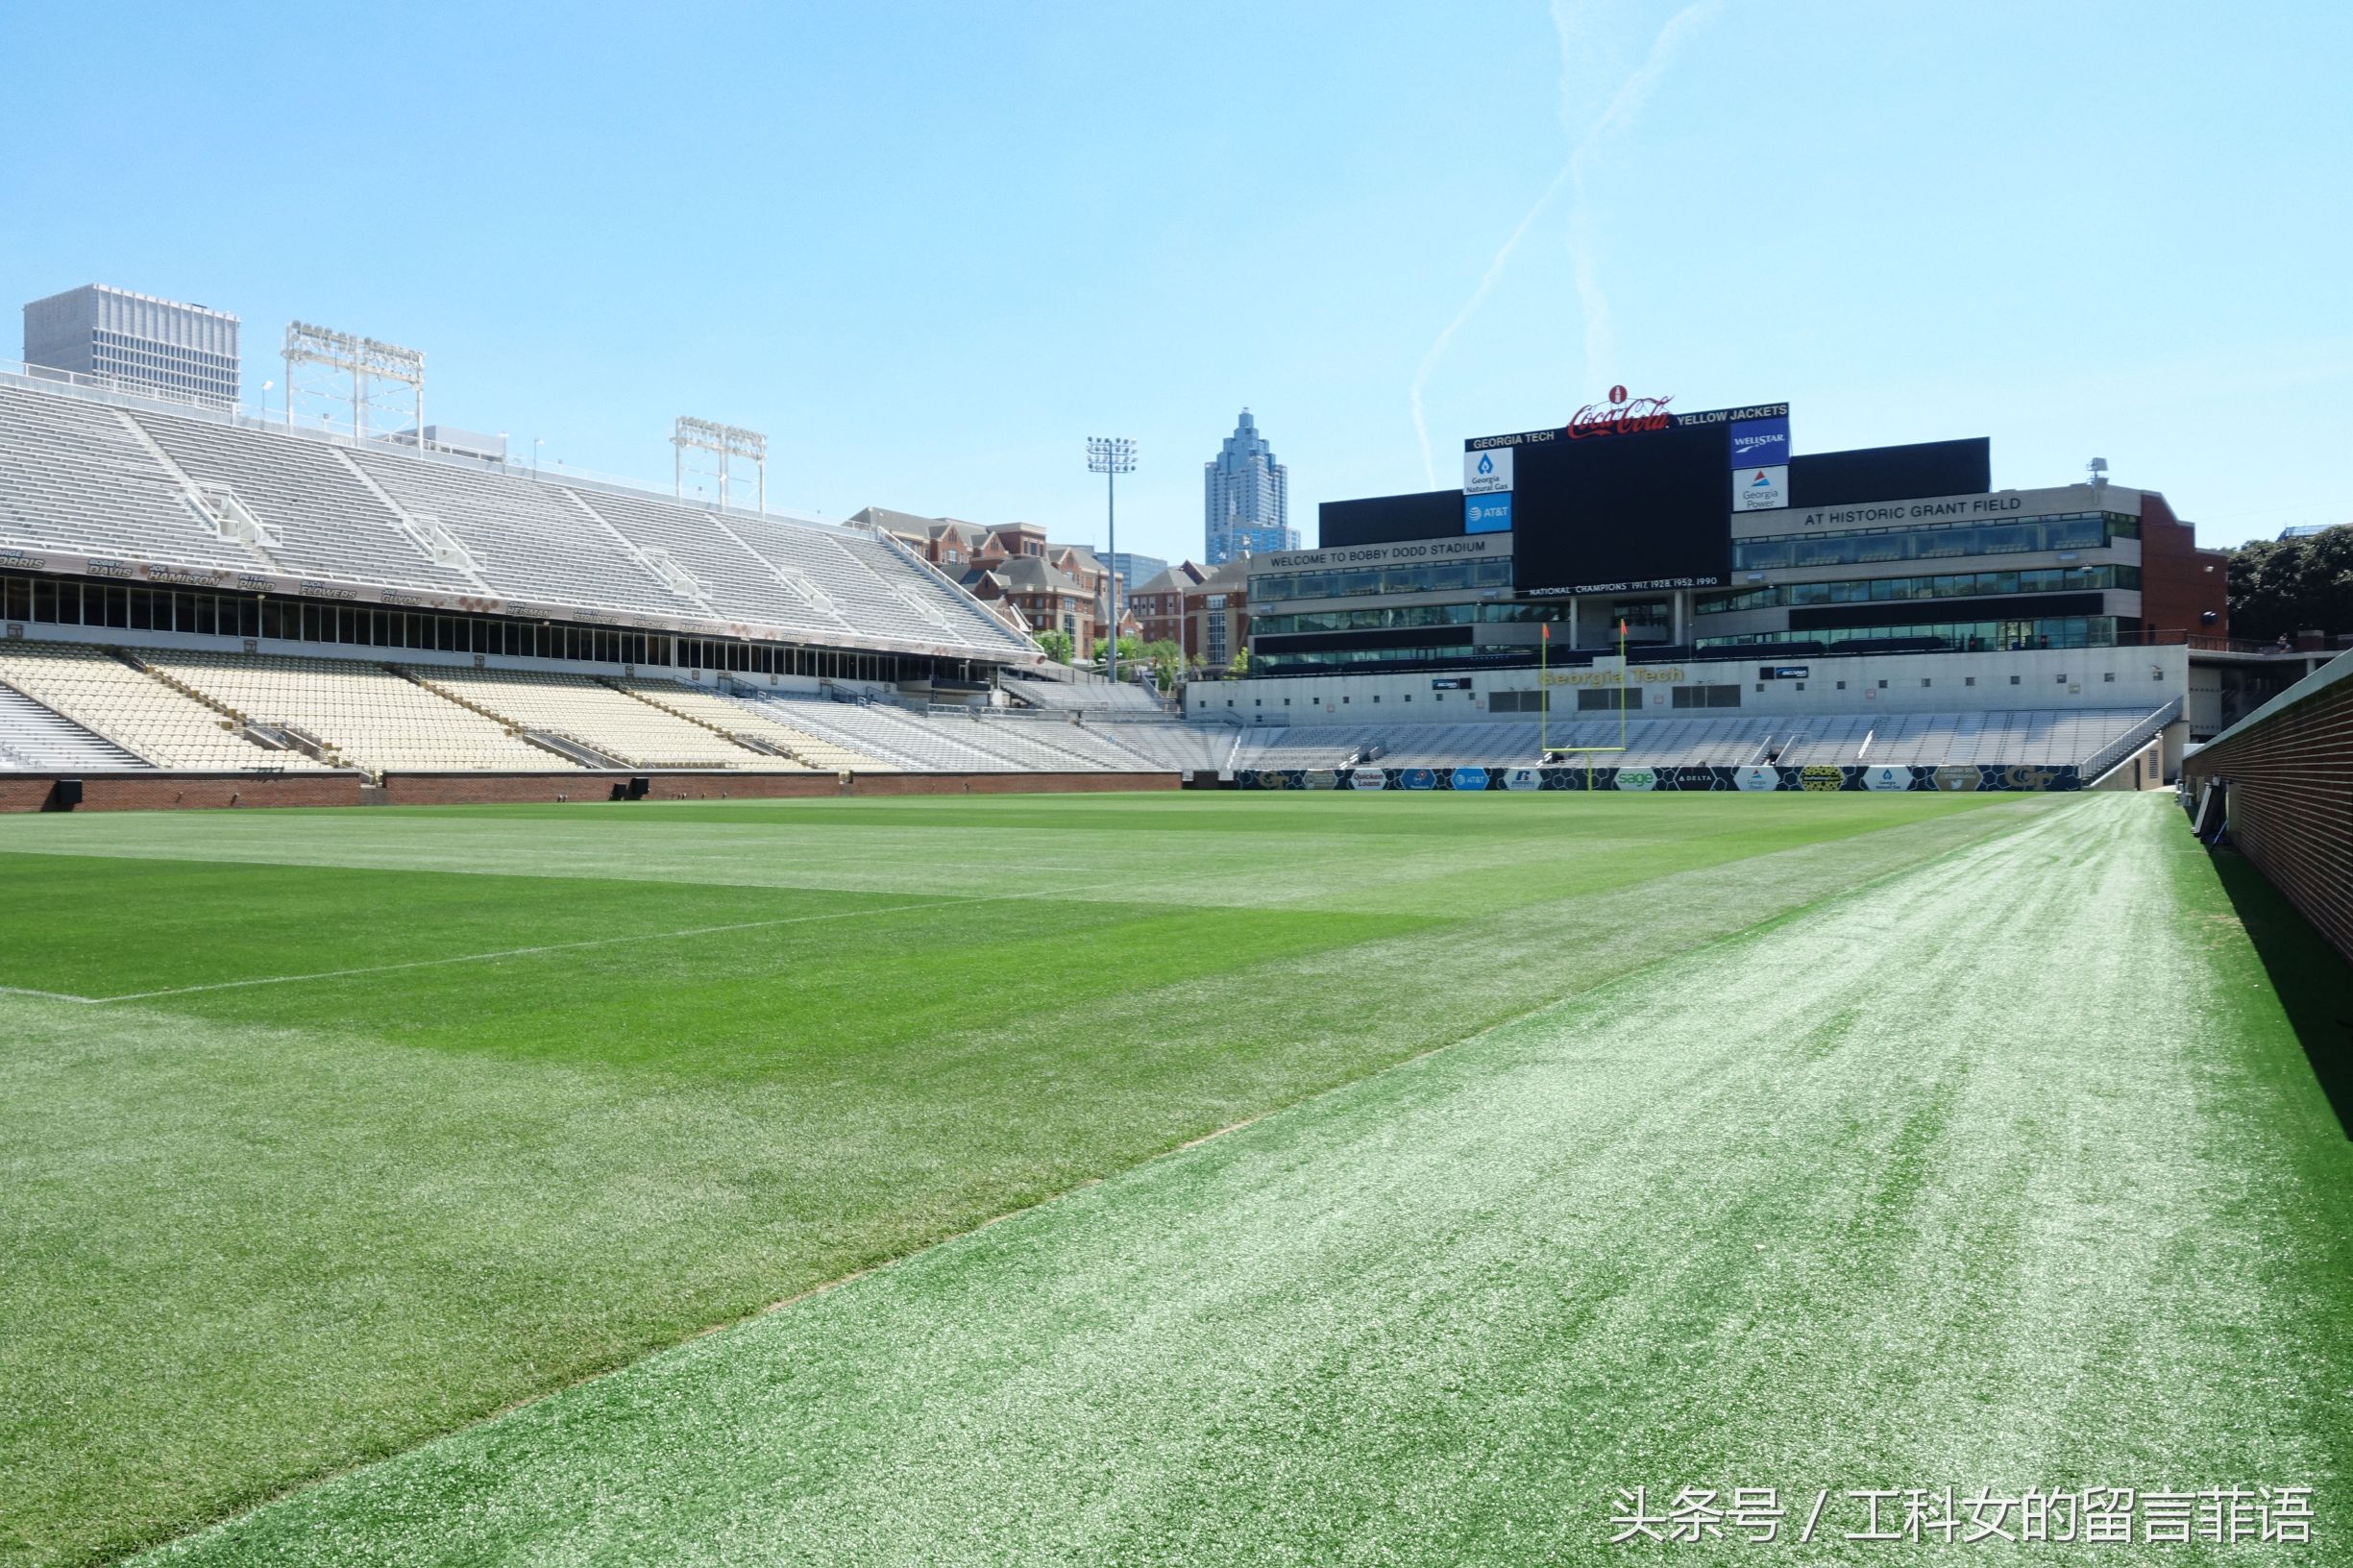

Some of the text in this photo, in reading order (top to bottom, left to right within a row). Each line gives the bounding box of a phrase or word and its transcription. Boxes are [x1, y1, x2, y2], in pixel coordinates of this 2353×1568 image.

[1678, 404, 1787, 426] YELLOW JACKETS
[1473, 430, 1555, 450] GEORGIA TECH
[1471, 476, 1500, 485] Georgia
[1466, 481, 1508, 493] Natural Gas
[1743, 489, 1778, 500] Georgia
[1747, 500, 1775, 508] Power
[1483, 506, 1508, 518] AT&T
[1804, 497, 2022, 526] AT HISTORIC GRANT FIELD
[1270, 541, 1485, 568] WELCOME TO BOBBY DODD STADIUM
[87, 557, 124, 568] BOBBY
[86, 565, 134, 578] DAVIS
[148, 572, 221, 587] HAMILTON
[237, 574, 266, 582] PETER
[236, 580, 276, 592] PUND
[1530, 586, 1571, 597] NATIONAL
[1575, 582, 1628, 594] CHAMPIONS
[1697, 576, 1718, 585] 1990
[299, 586, 357, 600] FLOWERS
[380, 595, 423, 606] GUYON
[505, 606, 552, 618] HEISMAN
[1538, 667, 1684, 687] Georgia Tech
[1466, 775, 1484, 784] AT&T
[1618, 773, 1654, 787] sage
